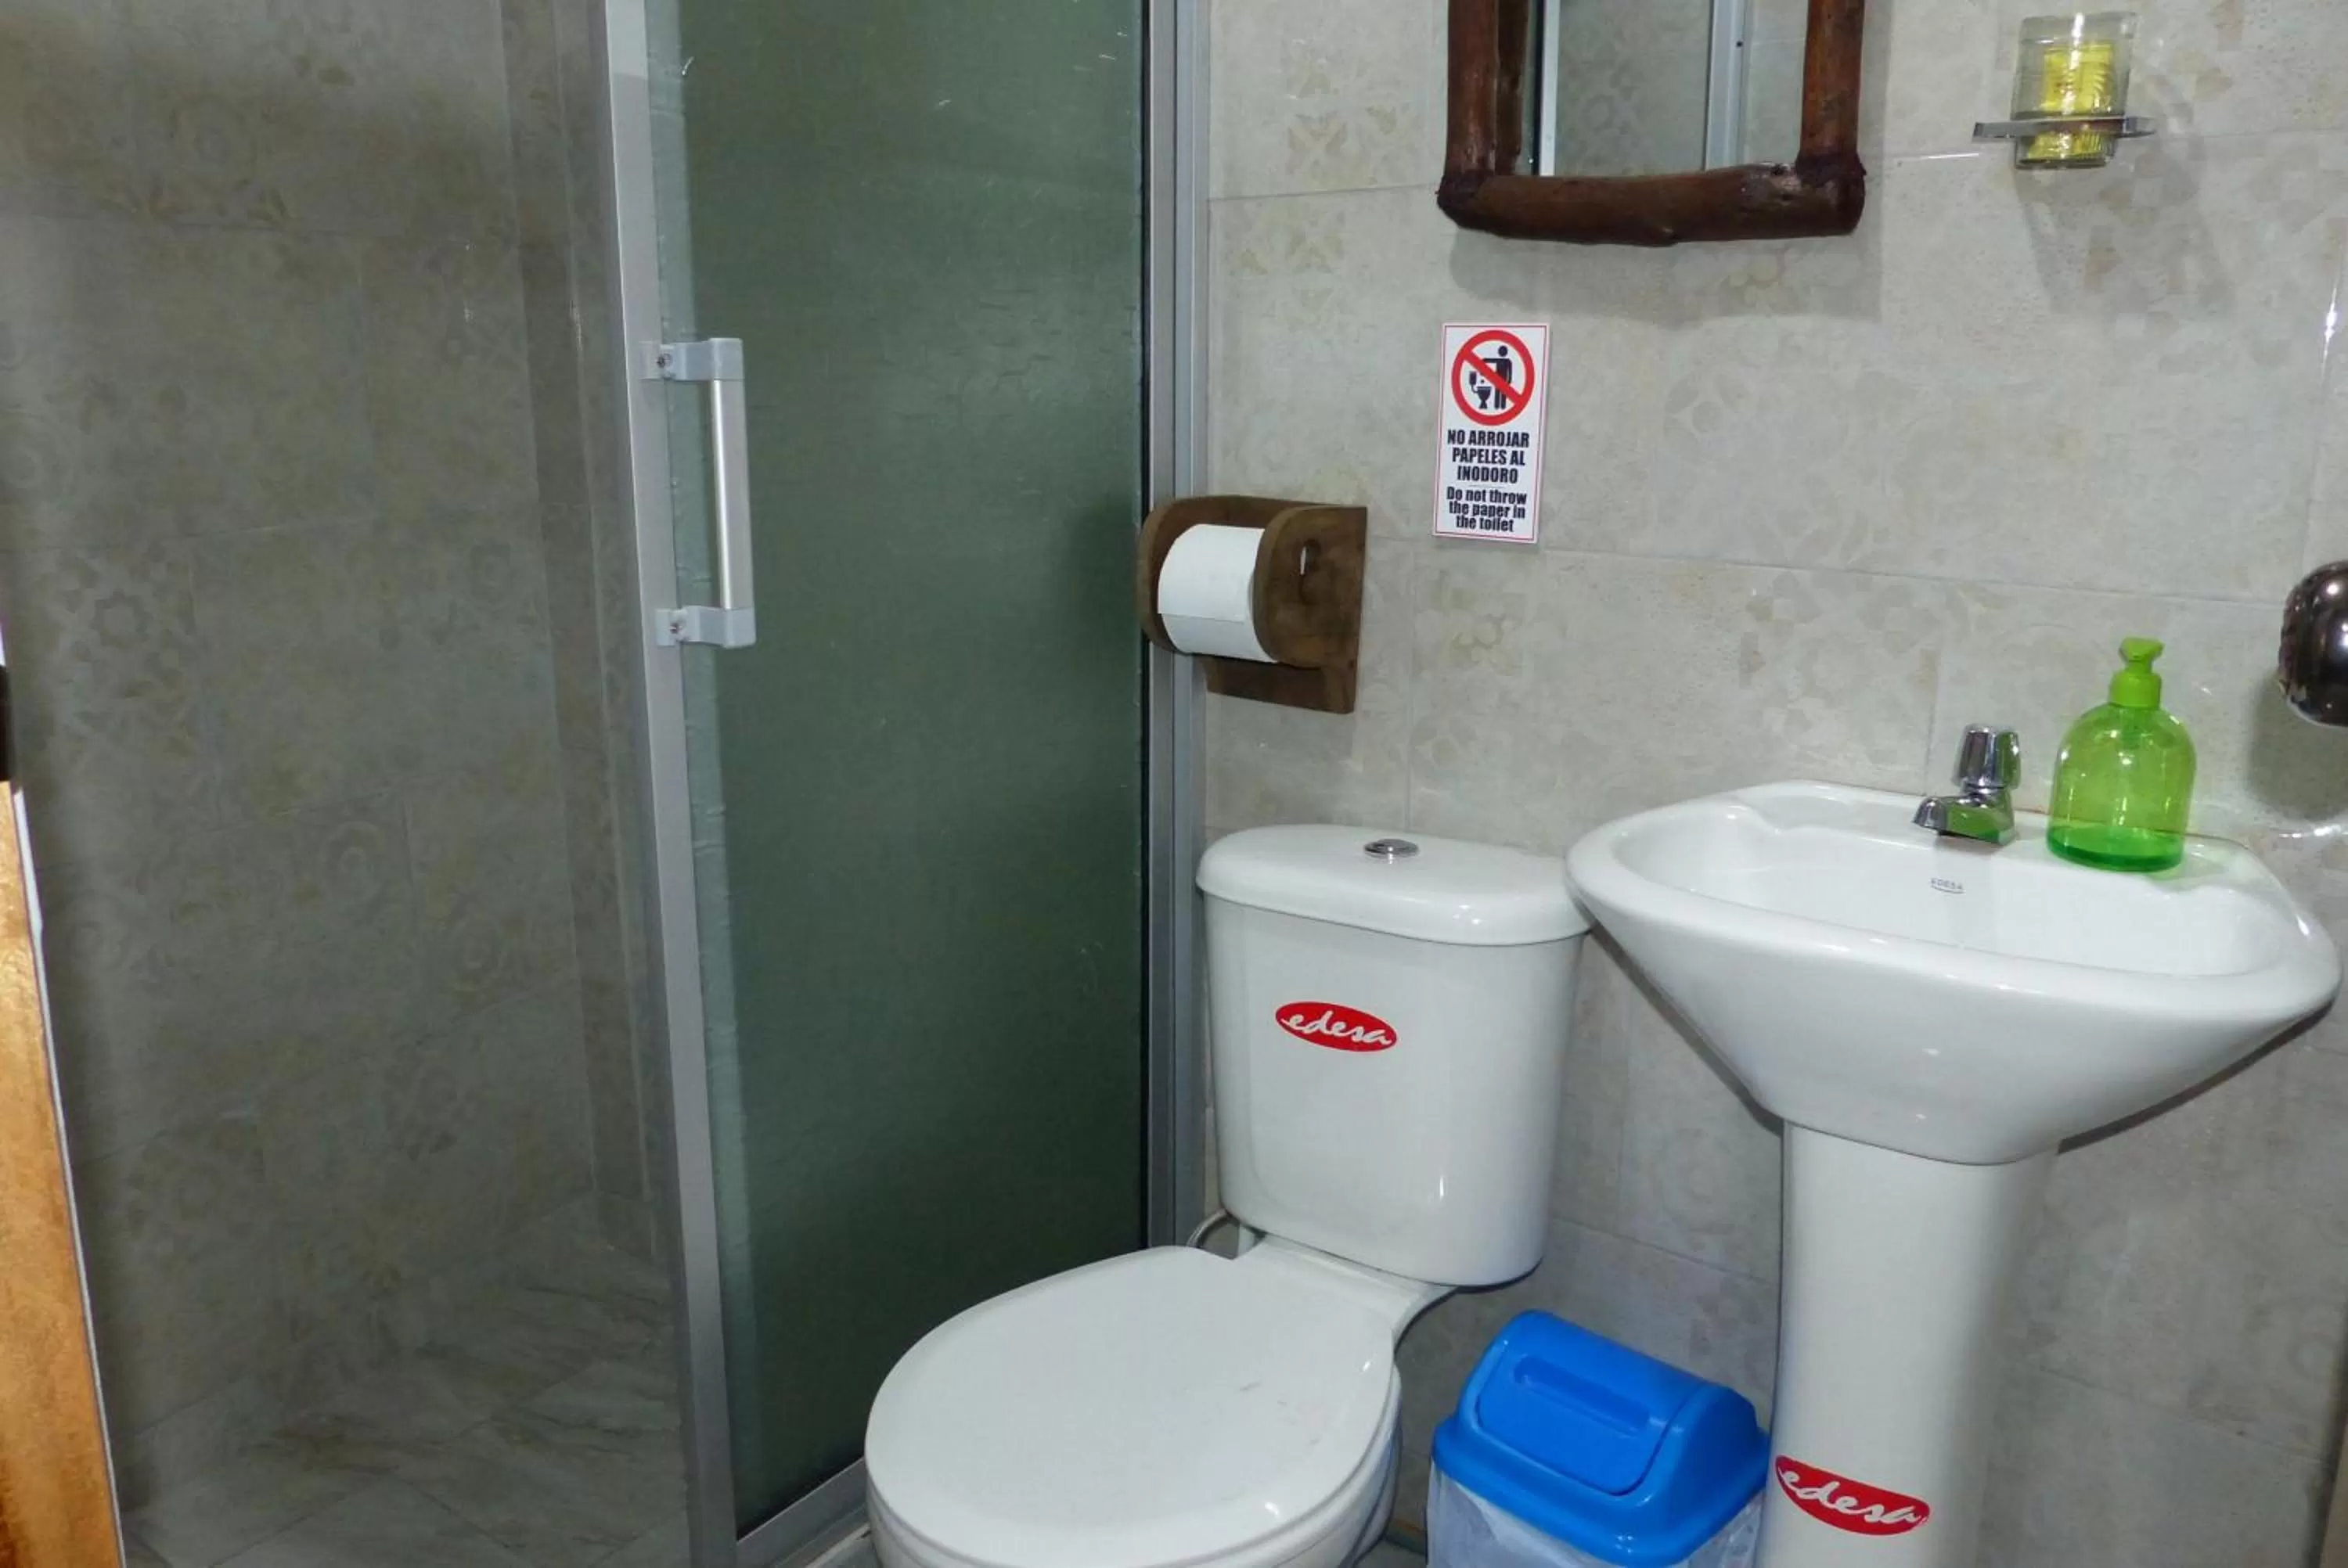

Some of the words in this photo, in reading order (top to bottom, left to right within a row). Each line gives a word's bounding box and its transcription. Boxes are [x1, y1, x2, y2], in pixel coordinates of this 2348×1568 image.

[1447, 429, 1465, 444] NO
[1468, 430, 1529, 448] ARROJAR
[1452, 448, 1507, 465] PAPELES
[1510, 450, 1525, 466] AL
[1457, 466, 1518, 484] INODORO
[1446, 486, 1463, 500] Do
[1465, 489, 1486, 502] not
[1489, 489, 1527, 505] throw
[1449, 501, 1469, 515] the
[1472, 503, 1511, 517] paper
[1514, 505, 1525, 519] in
[1456, 515, 1476, 529] the
[1479, 517, 1514, 532] toilet
[1280, 1010, 1392, 1045] edesa
[1777, 1466, 1925, 1523] edesa
